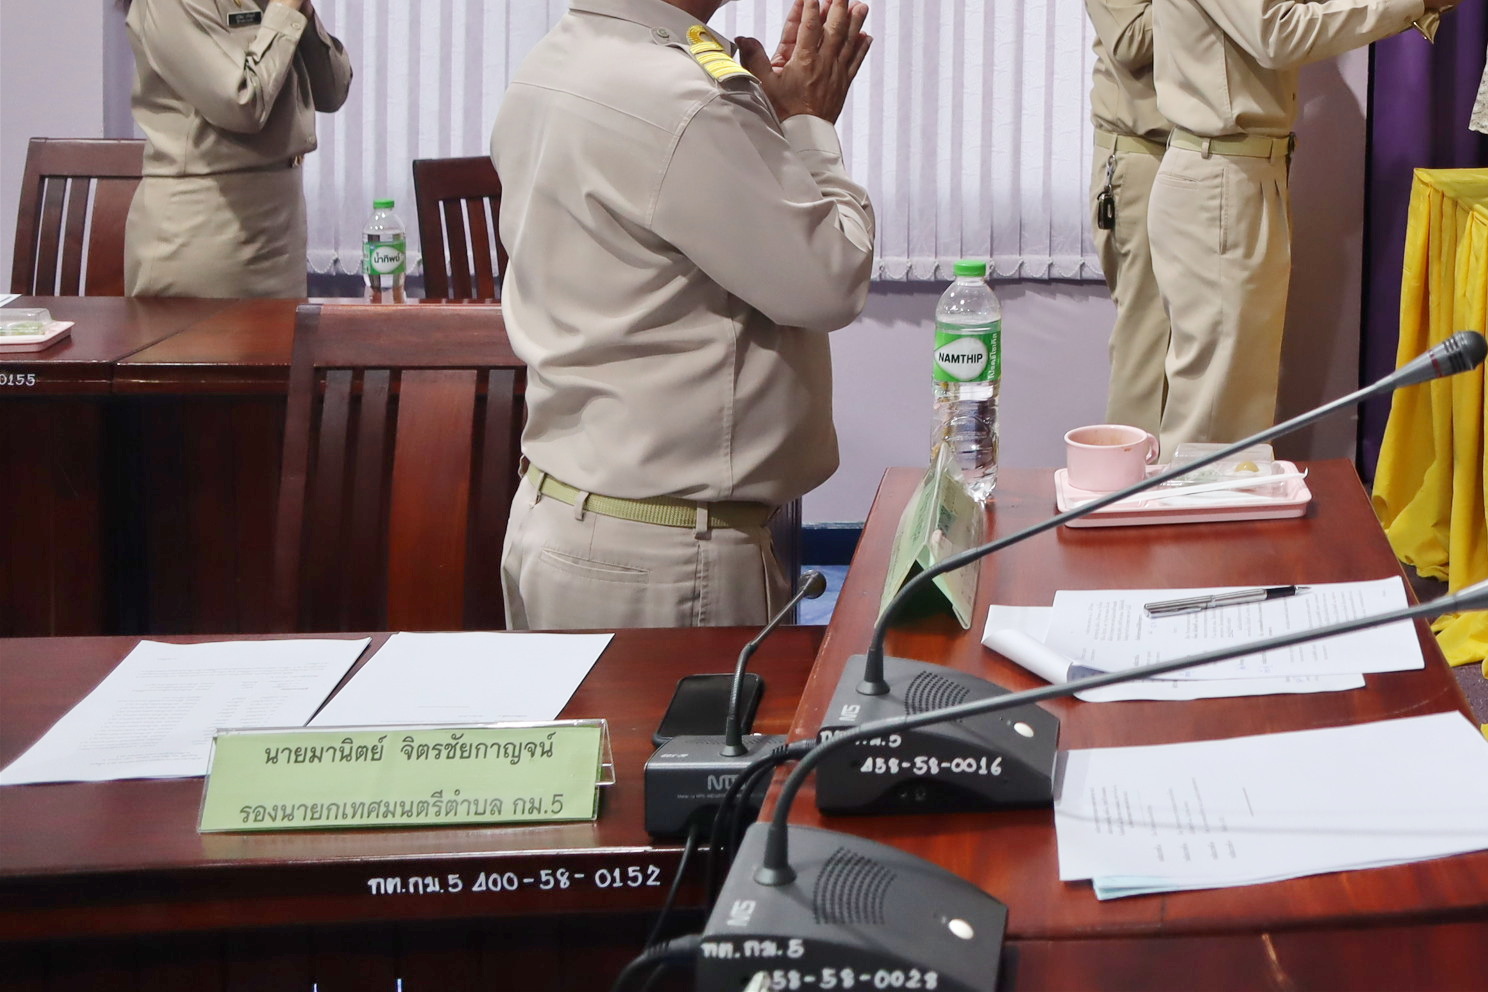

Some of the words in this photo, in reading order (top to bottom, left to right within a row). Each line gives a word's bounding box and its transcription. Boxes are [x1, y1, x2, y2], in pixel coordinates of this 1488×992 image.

[938, 352, 983, 364] NAMTHIP
[0, 373, 36, 386] 0155
[264, 735, 388, 765] นายมานิตย์
[400, 731, 556, 765] จิตรชัยกาญจน์
[239, 789, 503, 824] รองนายกเทศมนตรีตำบล
[512, 793, 564, 816] กม.5
[770, 967, 938, 991] 58-58-0028
